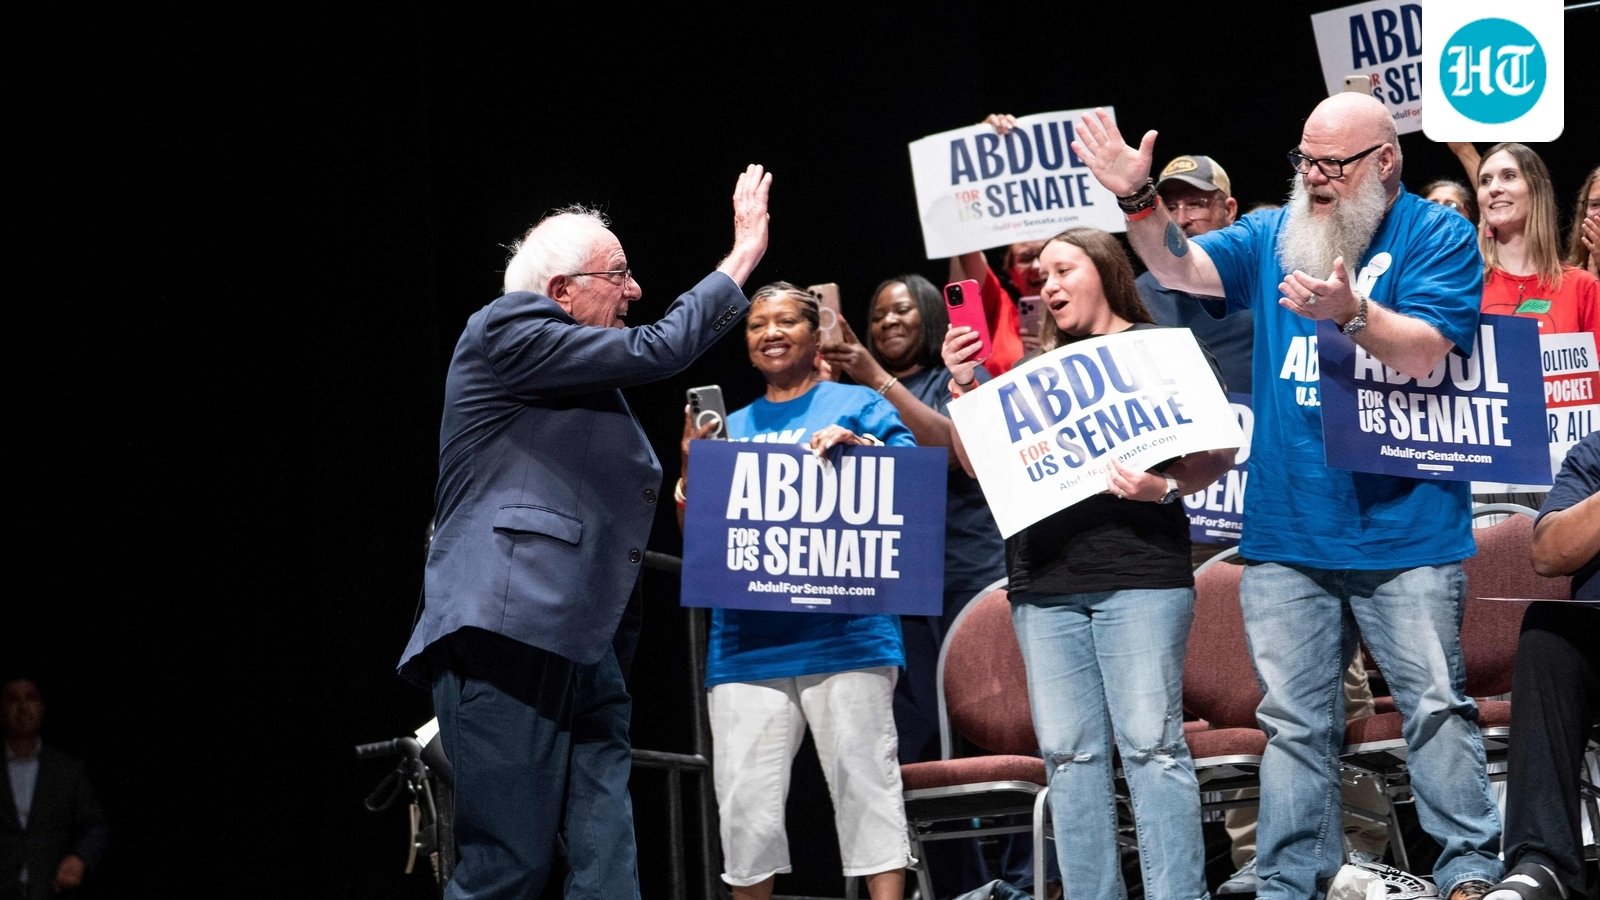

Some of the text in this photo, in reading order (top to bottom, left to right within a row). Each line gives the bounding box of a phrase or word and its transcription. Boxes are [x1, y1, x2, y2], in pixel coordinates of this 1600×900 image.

[950, 120, 1090, 186] ABDUL
[955, 189, 980, 205] FOR
[985, 173, 1094, 218] SENATE
[1543, 347, 1588, 372] OLITICS
[1296, 387, 1321, 406] U.S.
[1358, 389, 1384, 409] FOR
[1544, 377, 1593, 403] POCKET
[1359, 390, 1511, 447] US SENATE
[1027, 455, 1059, 483] US
[1056, 390, 1193, 469] SENATE
[1019, 441, 1051, 466] FOR
[1380, 445, 1492, 464] AbdulForSenate.com
[726, 452, 904, 525] ABDUL
[728, 528, 760, 548] FOR
[727, 526, 901, 579] US SENATE
[748, 581, 875, 596] AbdulForSenate.com
